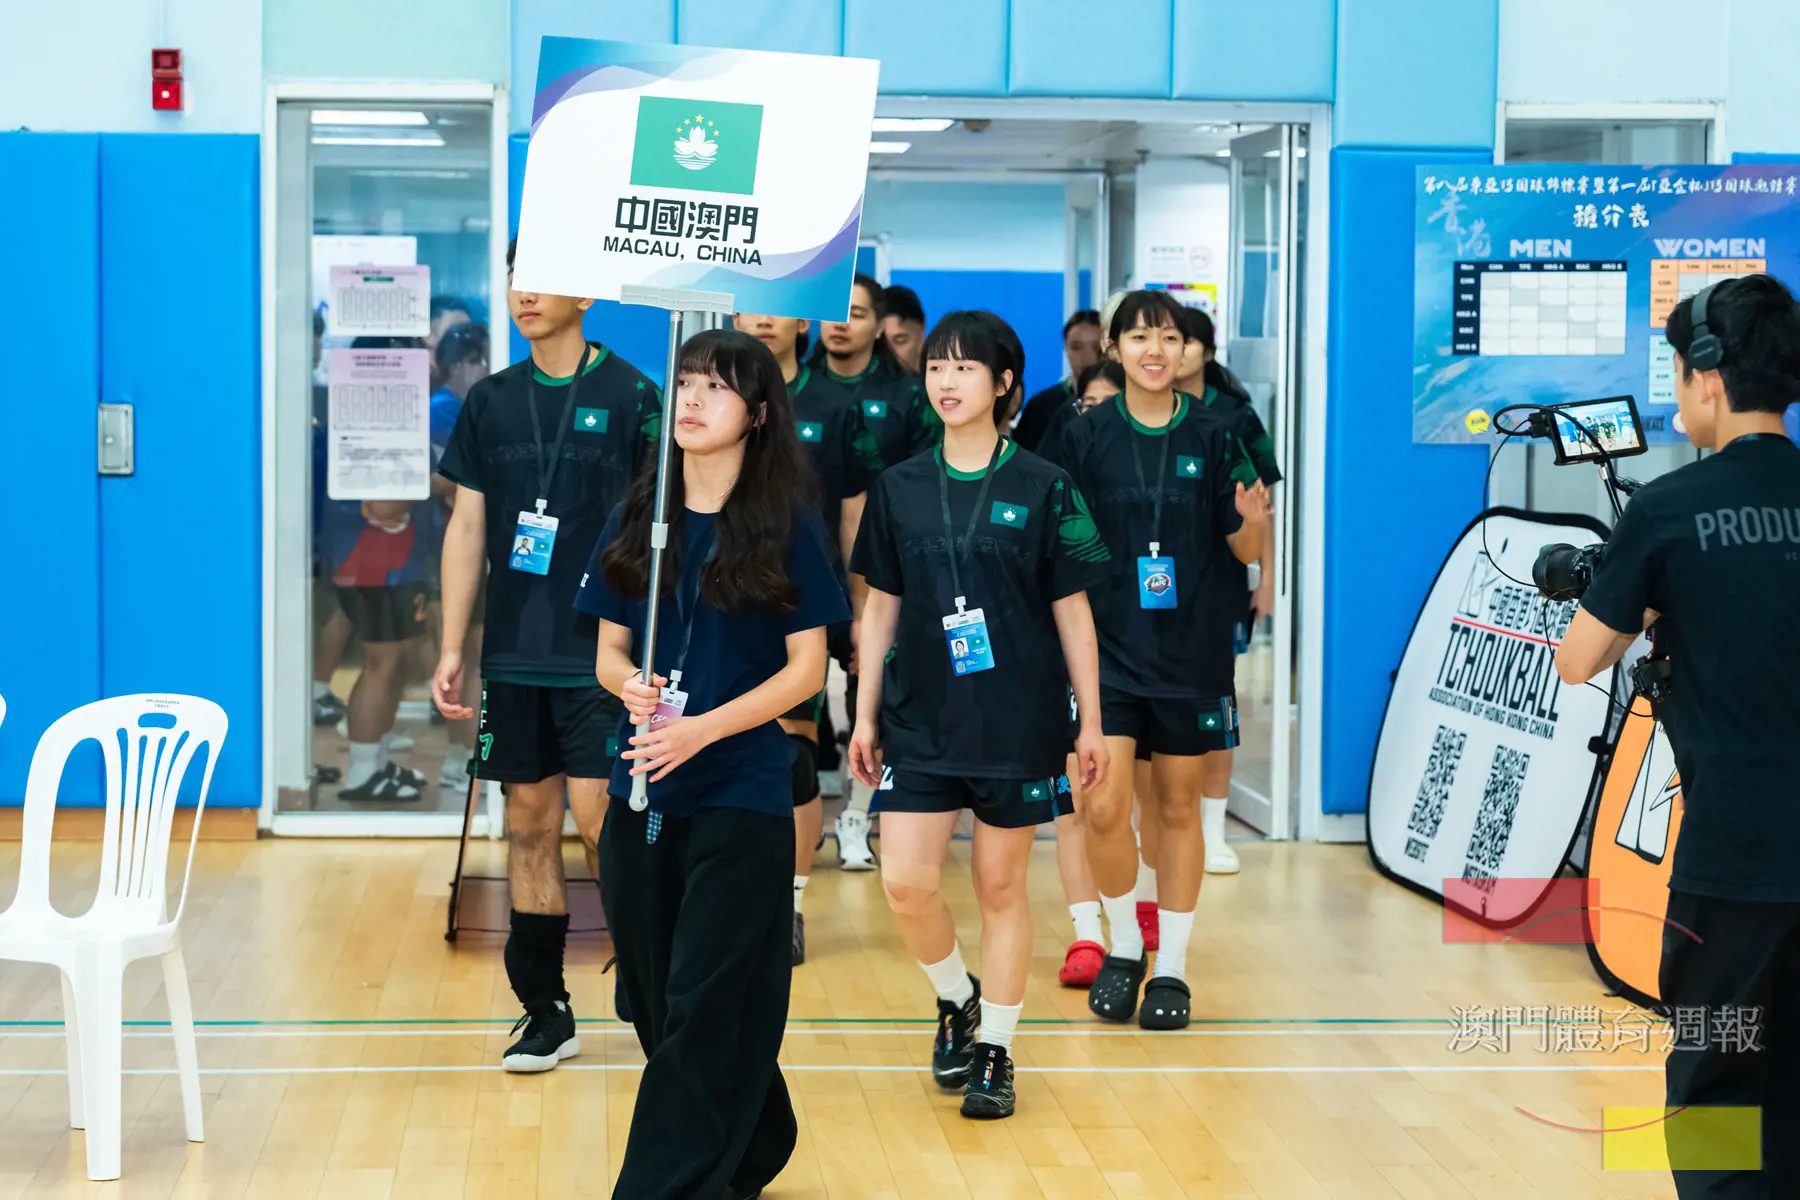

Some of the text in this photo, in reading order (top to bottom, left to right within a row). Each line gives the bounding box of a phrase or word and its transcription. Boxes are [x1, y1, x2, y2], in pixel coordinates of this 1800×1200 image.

[614, 195, 759, 245] 中國澳門
[603, 235, 763, 266] MACAU, CHINA
[1509, 238, 1572, 258] MEN
[1653, 237, 1765, 258] WOMEN
[1436, 622, 1560, 723] TCHOUKBALL
[1428, 687, 1555, 740] ASSOCIATION OF HONG KONG CHINA
[1461, 862, 1499, 897] INSTAGRAM
